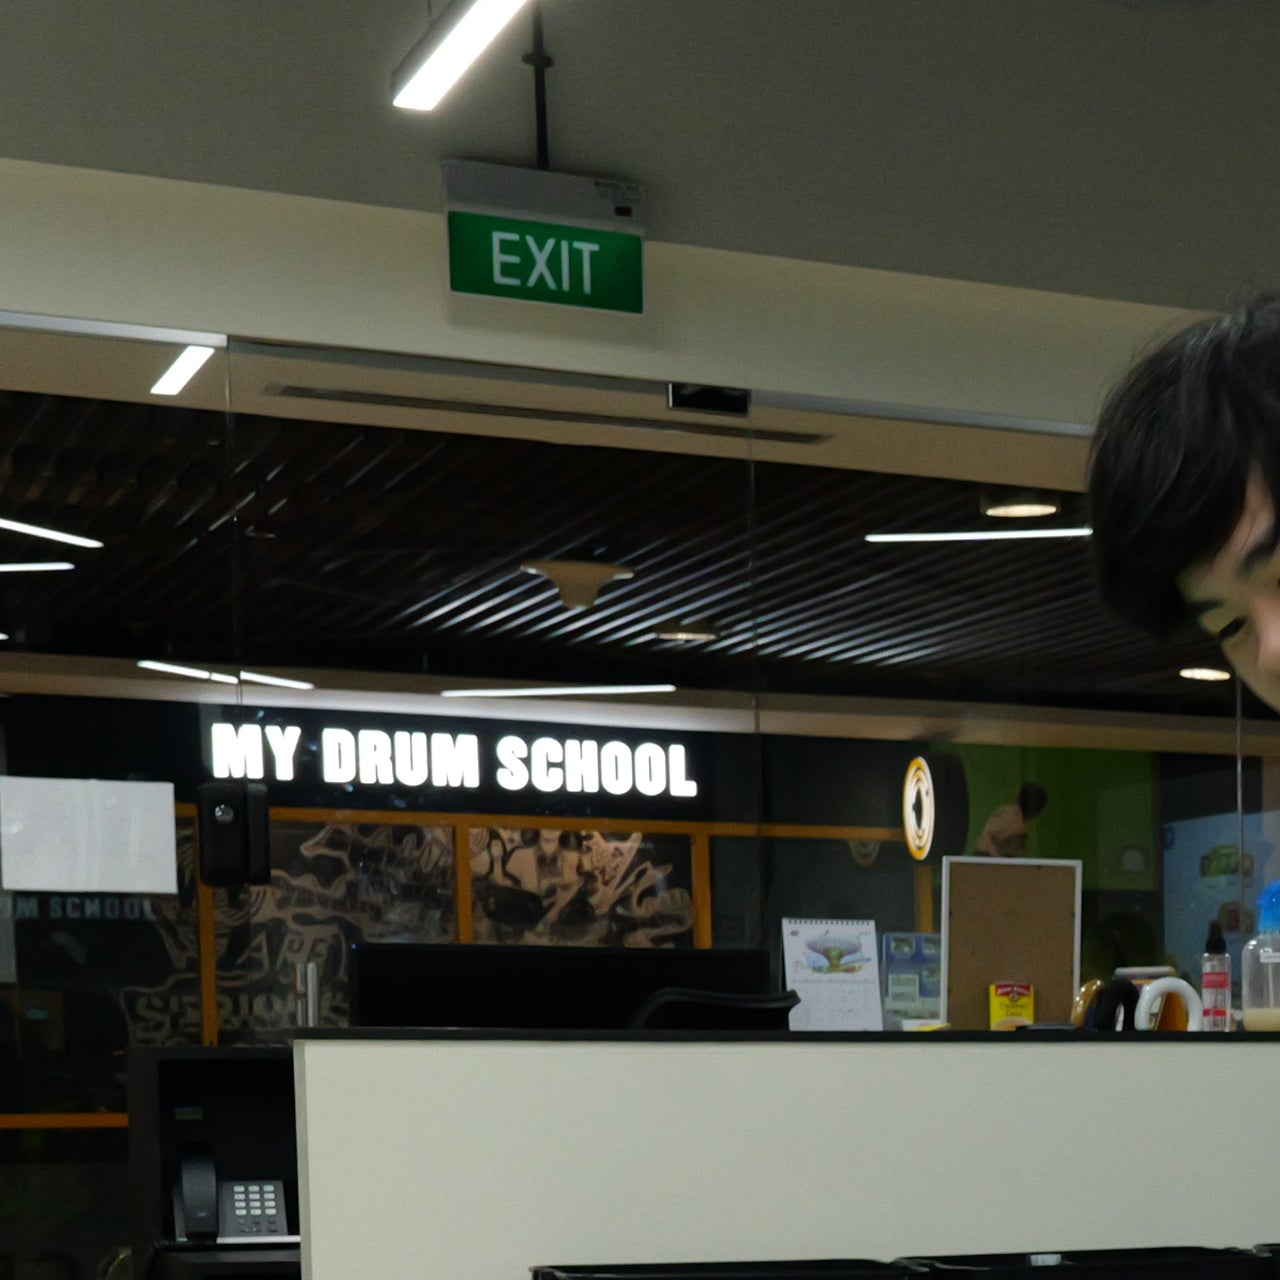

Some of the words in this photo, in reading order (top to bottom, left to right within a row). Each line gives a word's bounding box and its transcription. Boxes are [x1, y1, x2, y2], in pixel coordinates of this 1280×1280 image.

[491, 231, 600, 295] EXIT
[211, 723, 302, 781] MY
[321, 727, 480, 788] DRUM
[496, 735, 698, 798] SCHOOL
